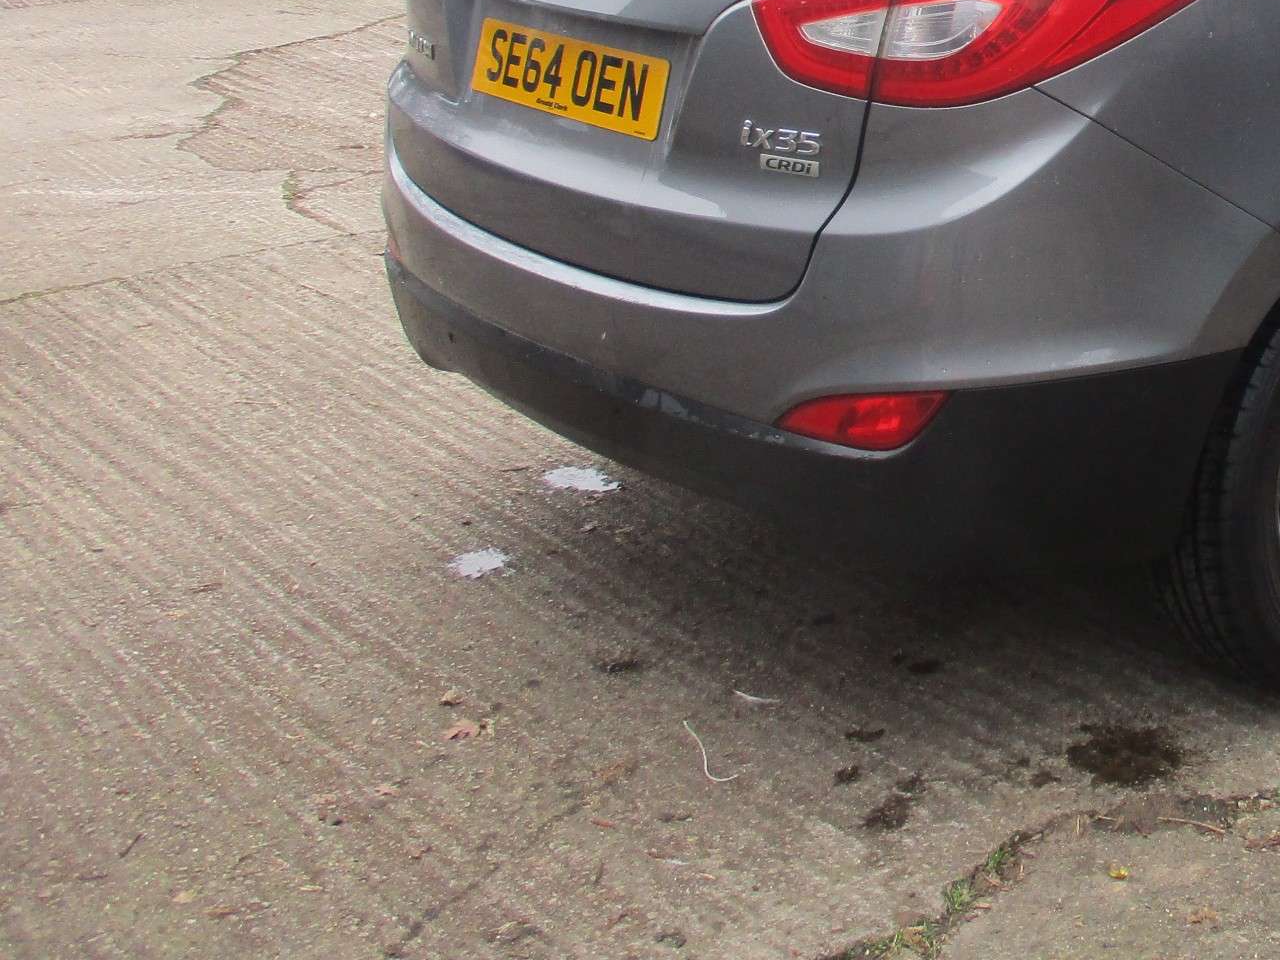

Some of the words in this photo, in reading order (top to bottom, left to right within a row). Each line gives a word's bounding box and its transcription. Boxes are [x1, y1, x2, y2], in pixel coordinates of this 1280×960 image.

[486, 28, 566, 99] SE64
[570, 49, 650, 122] OEN
[740, 119, 820, 156] ix35
[765, 158, 812, 174] CRDi
